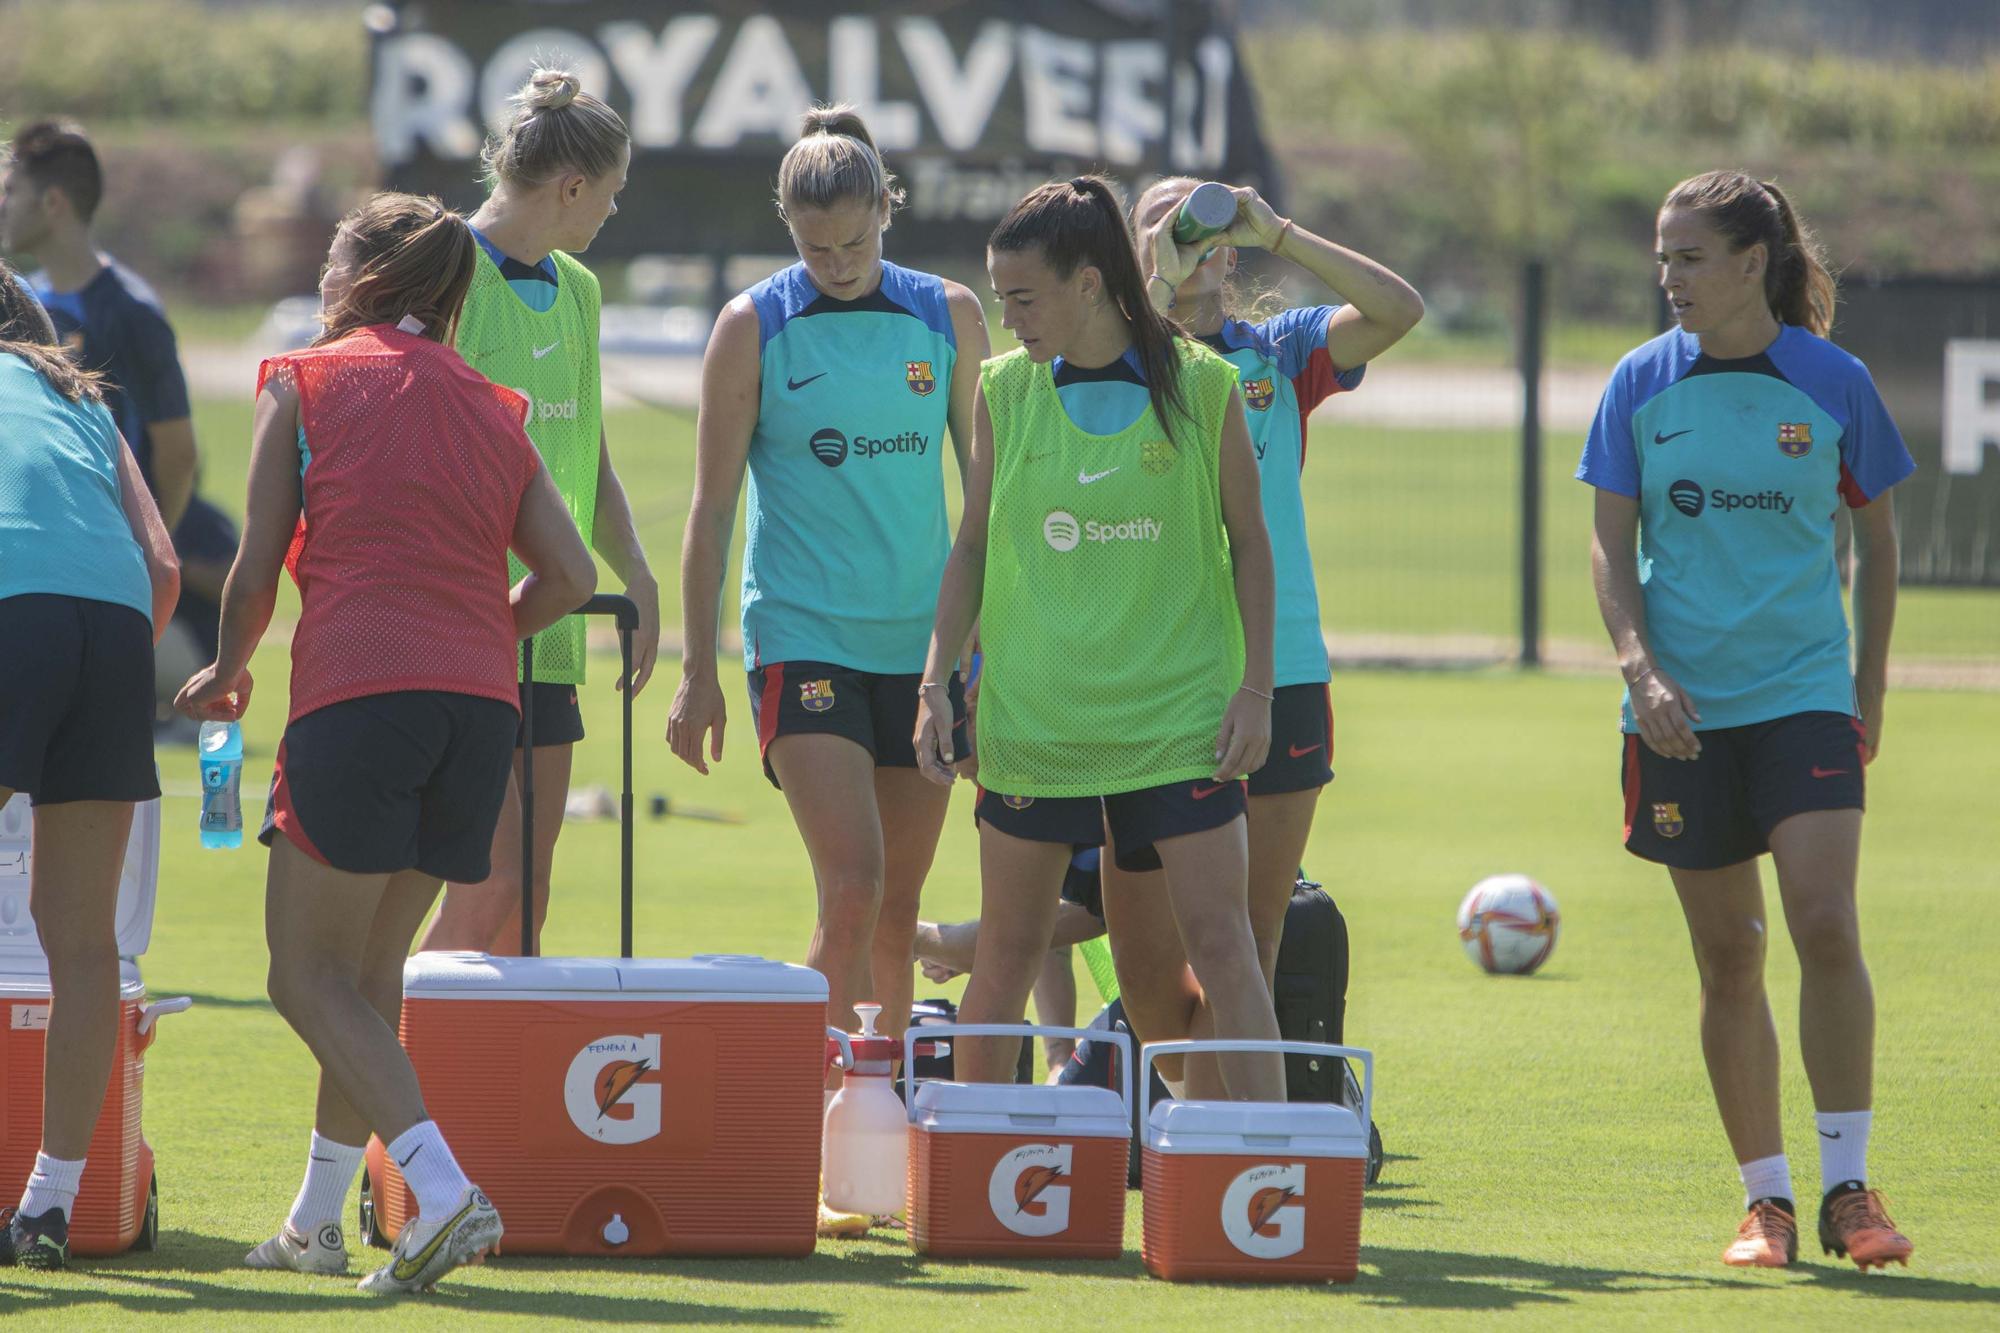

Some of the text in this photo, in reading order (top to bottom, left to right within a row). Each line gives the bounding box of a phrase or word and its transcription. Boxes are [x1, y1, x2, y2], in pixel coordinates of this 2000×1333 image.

[853, 431, 928, 458] Spotify
[1085, 518, 1163, 544] Spotify
[1711, 490, 1794, 514] Spotify
[564, 1033, 661, 1144] G
[988, 1144, 1072, 1237] G
[1221, 1164, 1305, 1259] G
